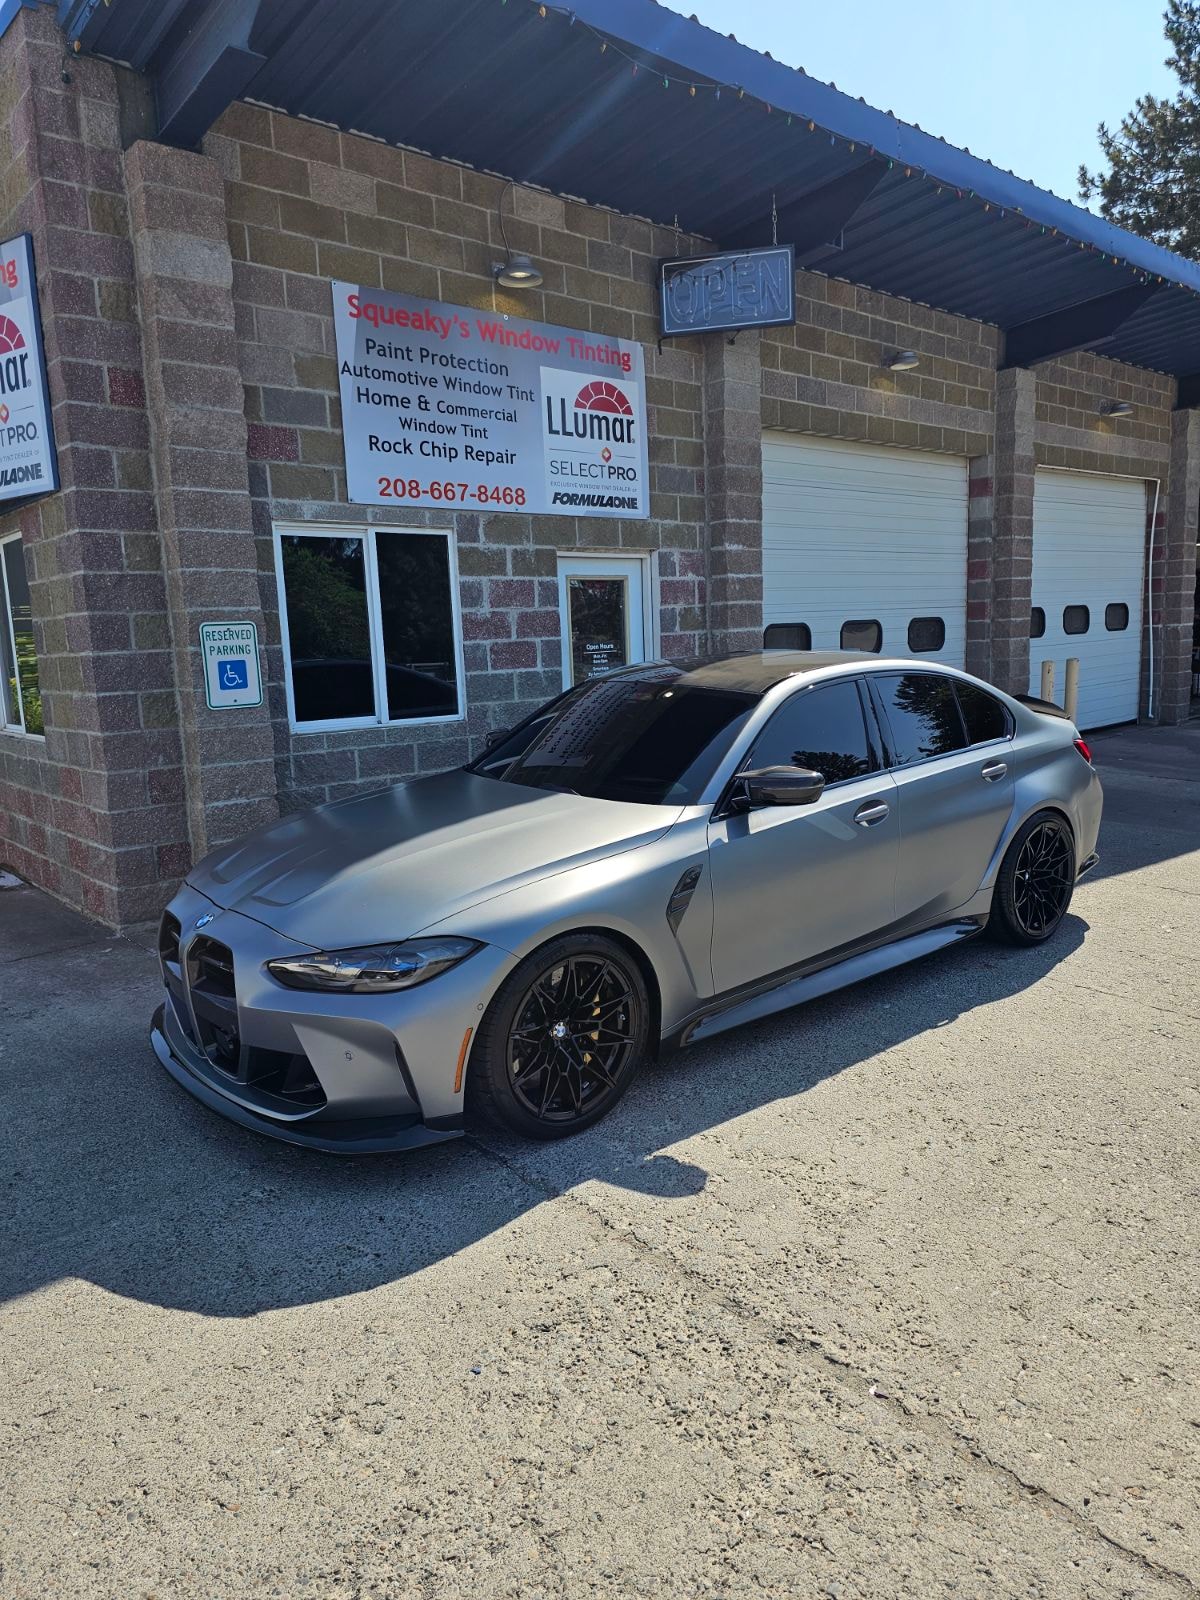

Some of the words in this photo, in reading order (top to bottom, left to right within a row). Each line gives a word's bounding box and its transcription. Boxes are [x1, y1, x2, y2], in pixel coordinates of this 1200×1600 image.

[667, 257, 788, 324] OPEN
[347, 294, 471, 340] Squeaky's
[476, 319, 561, 353] Window
[566, 336, 632, 372] Tinting
[0, 352, 28, 394] ar
[365, 338, 413, 362] Paint
[419, 347, 509, 377] Protection
[341, 360, 438, 388] Automotive
[443, 375, 502, 397] Window
[507, 385, 535, 402] Tint
[357, 386, 411, 410] Home
[418, 395, 431, 412] &
[437, 400, 517, 423] Commercial
[546, 395, 635, 444] LLumar
[399, 416, 457, 436] Window
[461, 423, 489, 440] Tint
[368, 434, 414, 456] Rock
[420, 440, 458, 463] Chip
[465, 445, 517, 466] Repair
[378, 477, 526, 506] 208-667-8468
[205, 629, 252, 642] RESERVED
[209, 644, 251, 656] PARKING
